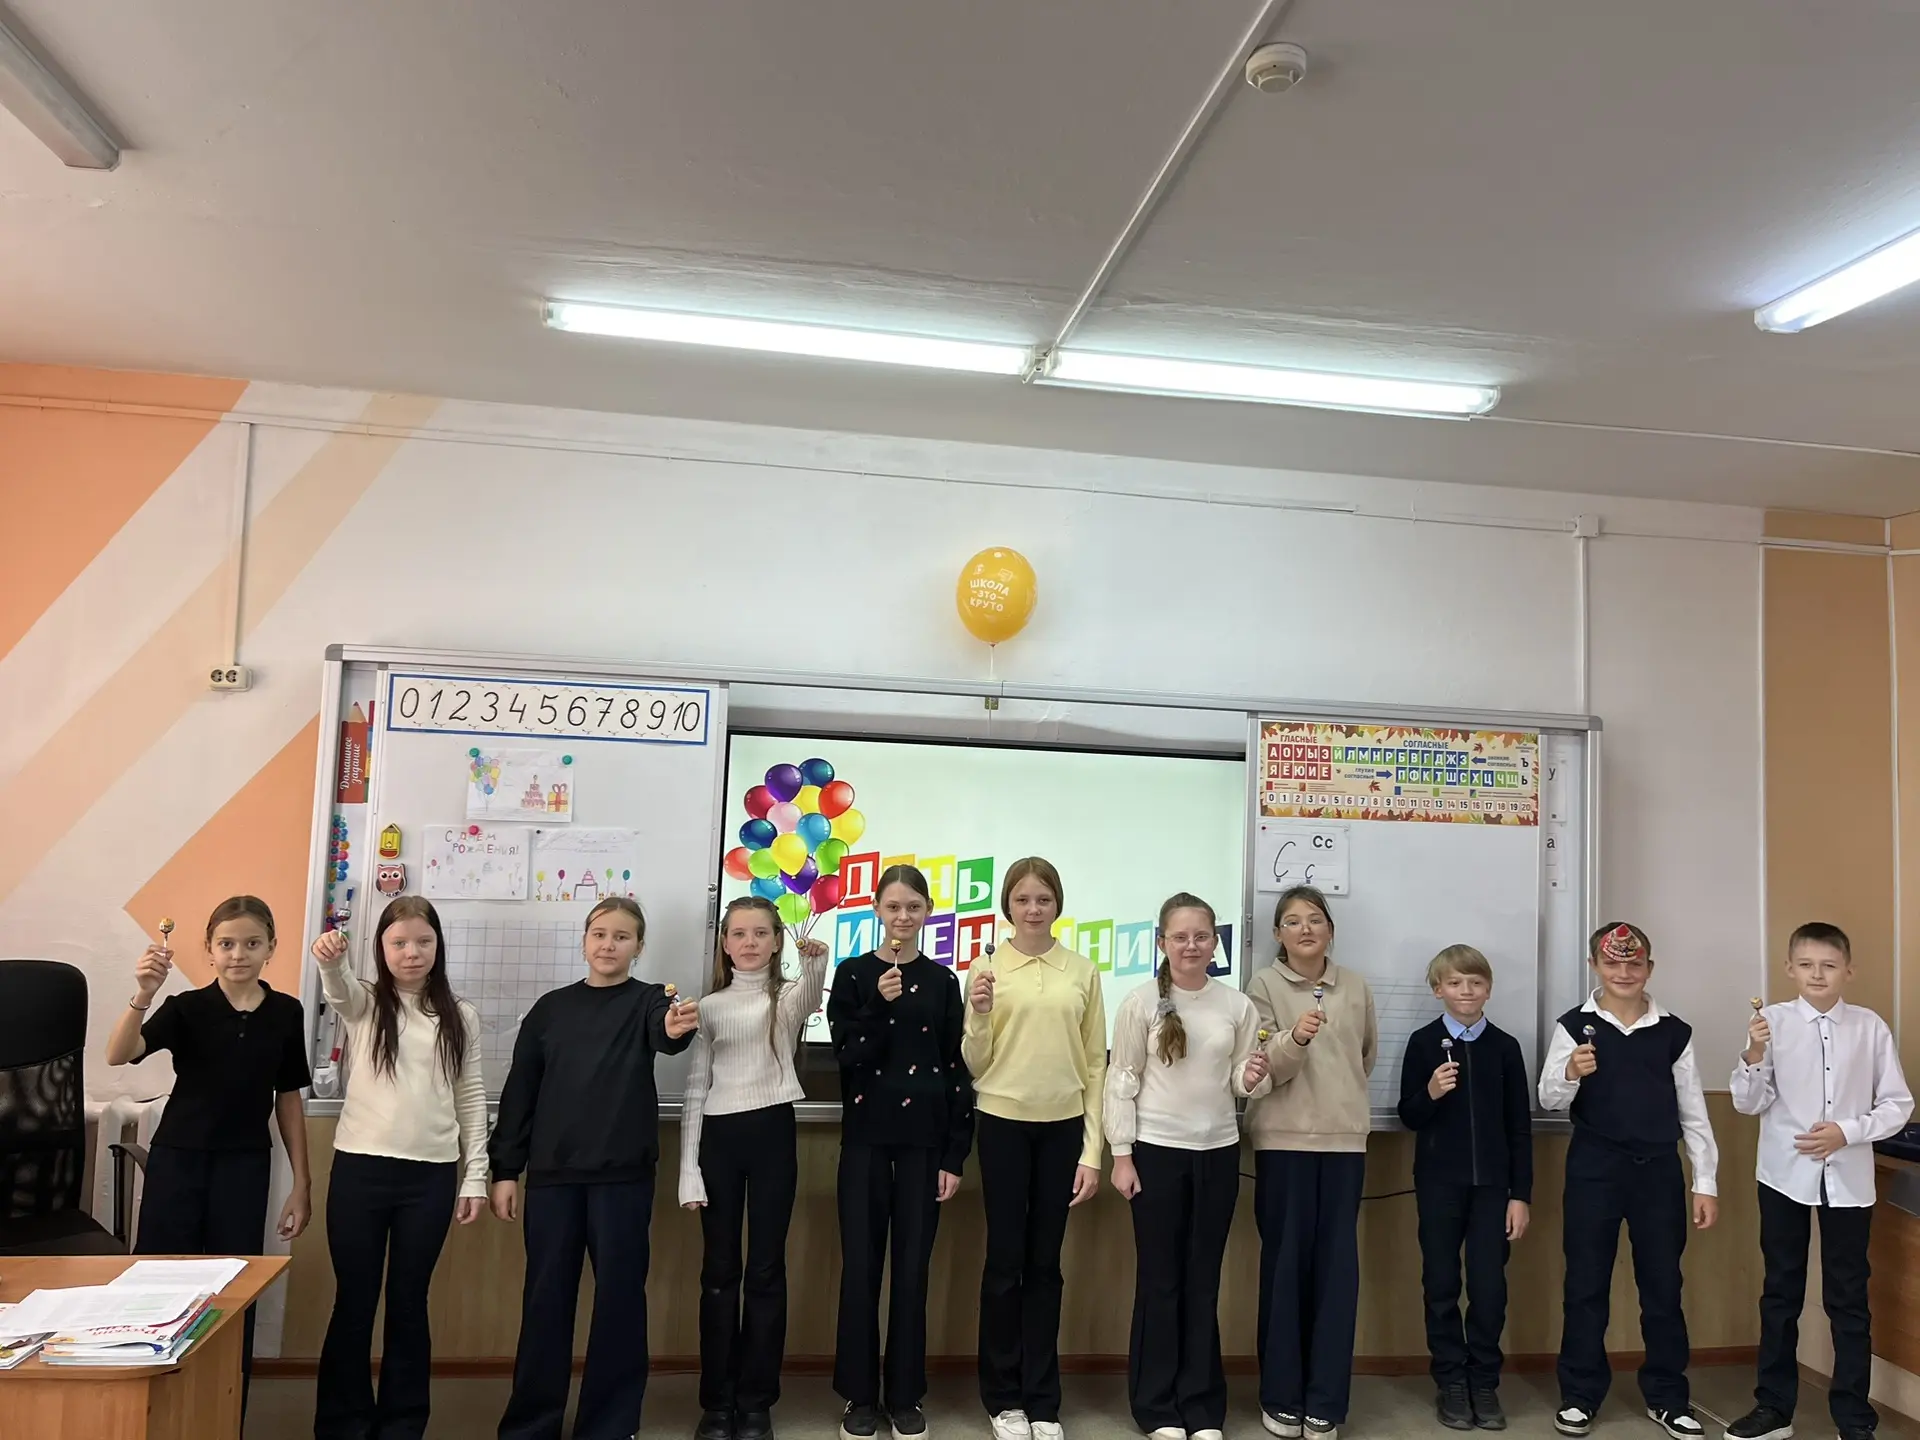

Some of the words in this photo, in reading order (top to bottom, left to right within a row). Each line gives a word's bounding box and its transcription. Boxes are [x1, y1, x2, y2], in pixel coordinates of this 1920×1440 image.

[970, 578, 1010, 597] ШКОЛА
[970, 597, 1004, 612] КРУТО
[1280, 735, 1318, 744] ГЛАСНЫЕ
[1403, 740, 1449, 749] СОГЛАСНЫЕ
[340, 736, 353, 790] Домашнее
[351, 743, 364, 785] задание
[1269, 794, 1274, 802] 0
[1296, 795, 1301, 803] 2
[1309, 795, 1314, 803] 3
[1334, 796, 1339, 804] 5
[1347, 797, 1352, 805] 6
[1360, 797, 1366, 805] 7
[1386, 798, 1391, 806] 9
[1397, 799, 1405, 807] 10
[1410, 799, 1417, 807] 11
[1423, 800, 1431, 808] 12
[1435, 800, 1443, 808] 13
[1460, 801, 1468, 809] 15
[1485, 802, 1493, 810] 17
[1498, 803, 1506, 811] 18
[1510, 803, 1518, 811] 19
[1522, 803, 1531, 811] 20
[445, 830, 453, 842] С
[841, 856, 991, 905] ДНЬ
